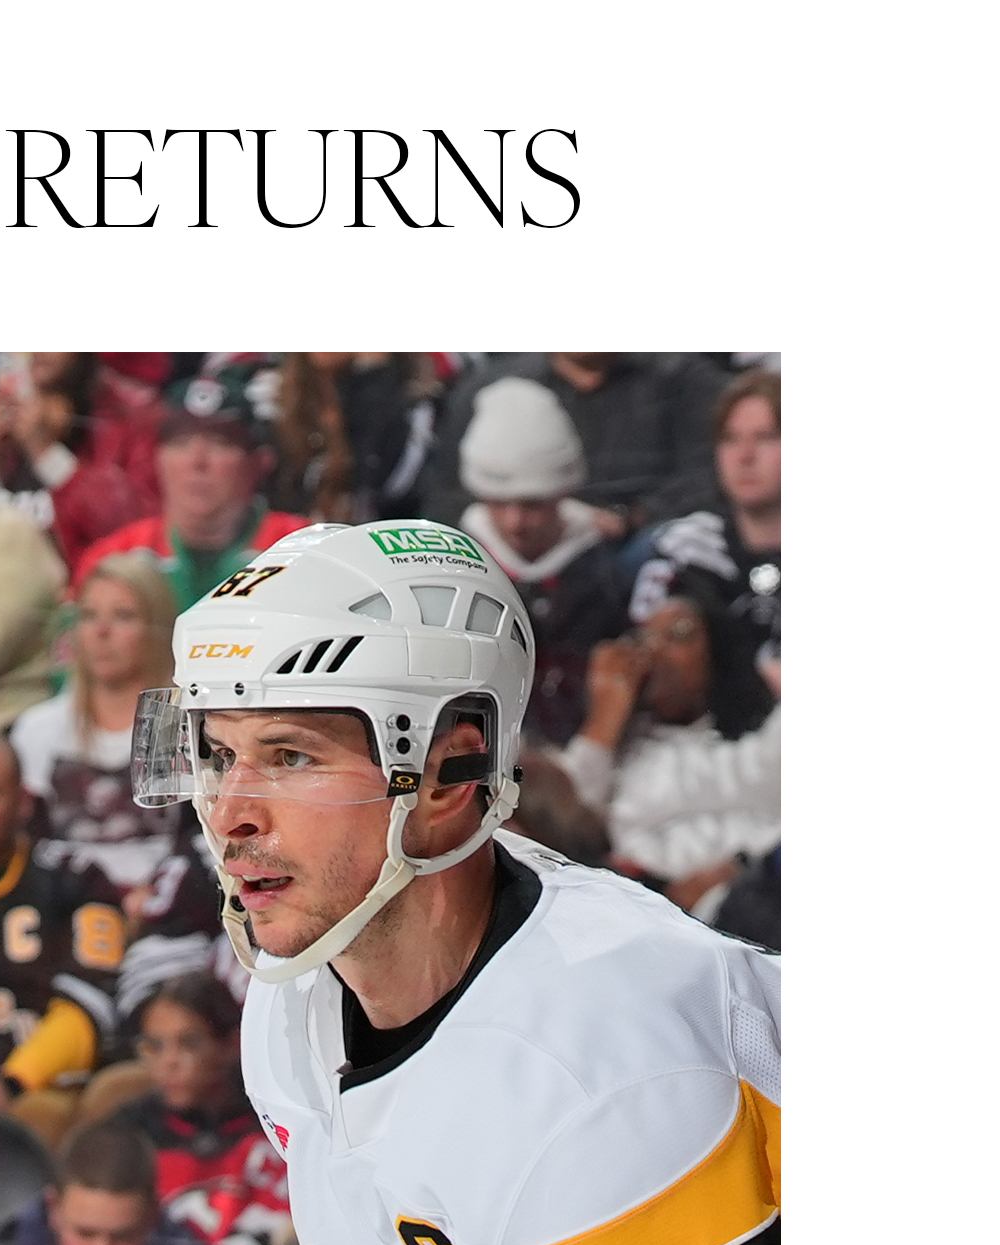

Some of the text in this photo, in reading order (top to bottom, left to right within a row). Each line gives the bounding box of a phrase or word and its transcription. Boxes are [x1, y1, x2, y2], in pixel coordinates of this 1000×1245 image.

[379, 529, 478, 559] MSA
[389, 554, 488, 573] The Safety Company
[211, 566, 288, 599] 87
[189, 643, 255, 659] CCM
